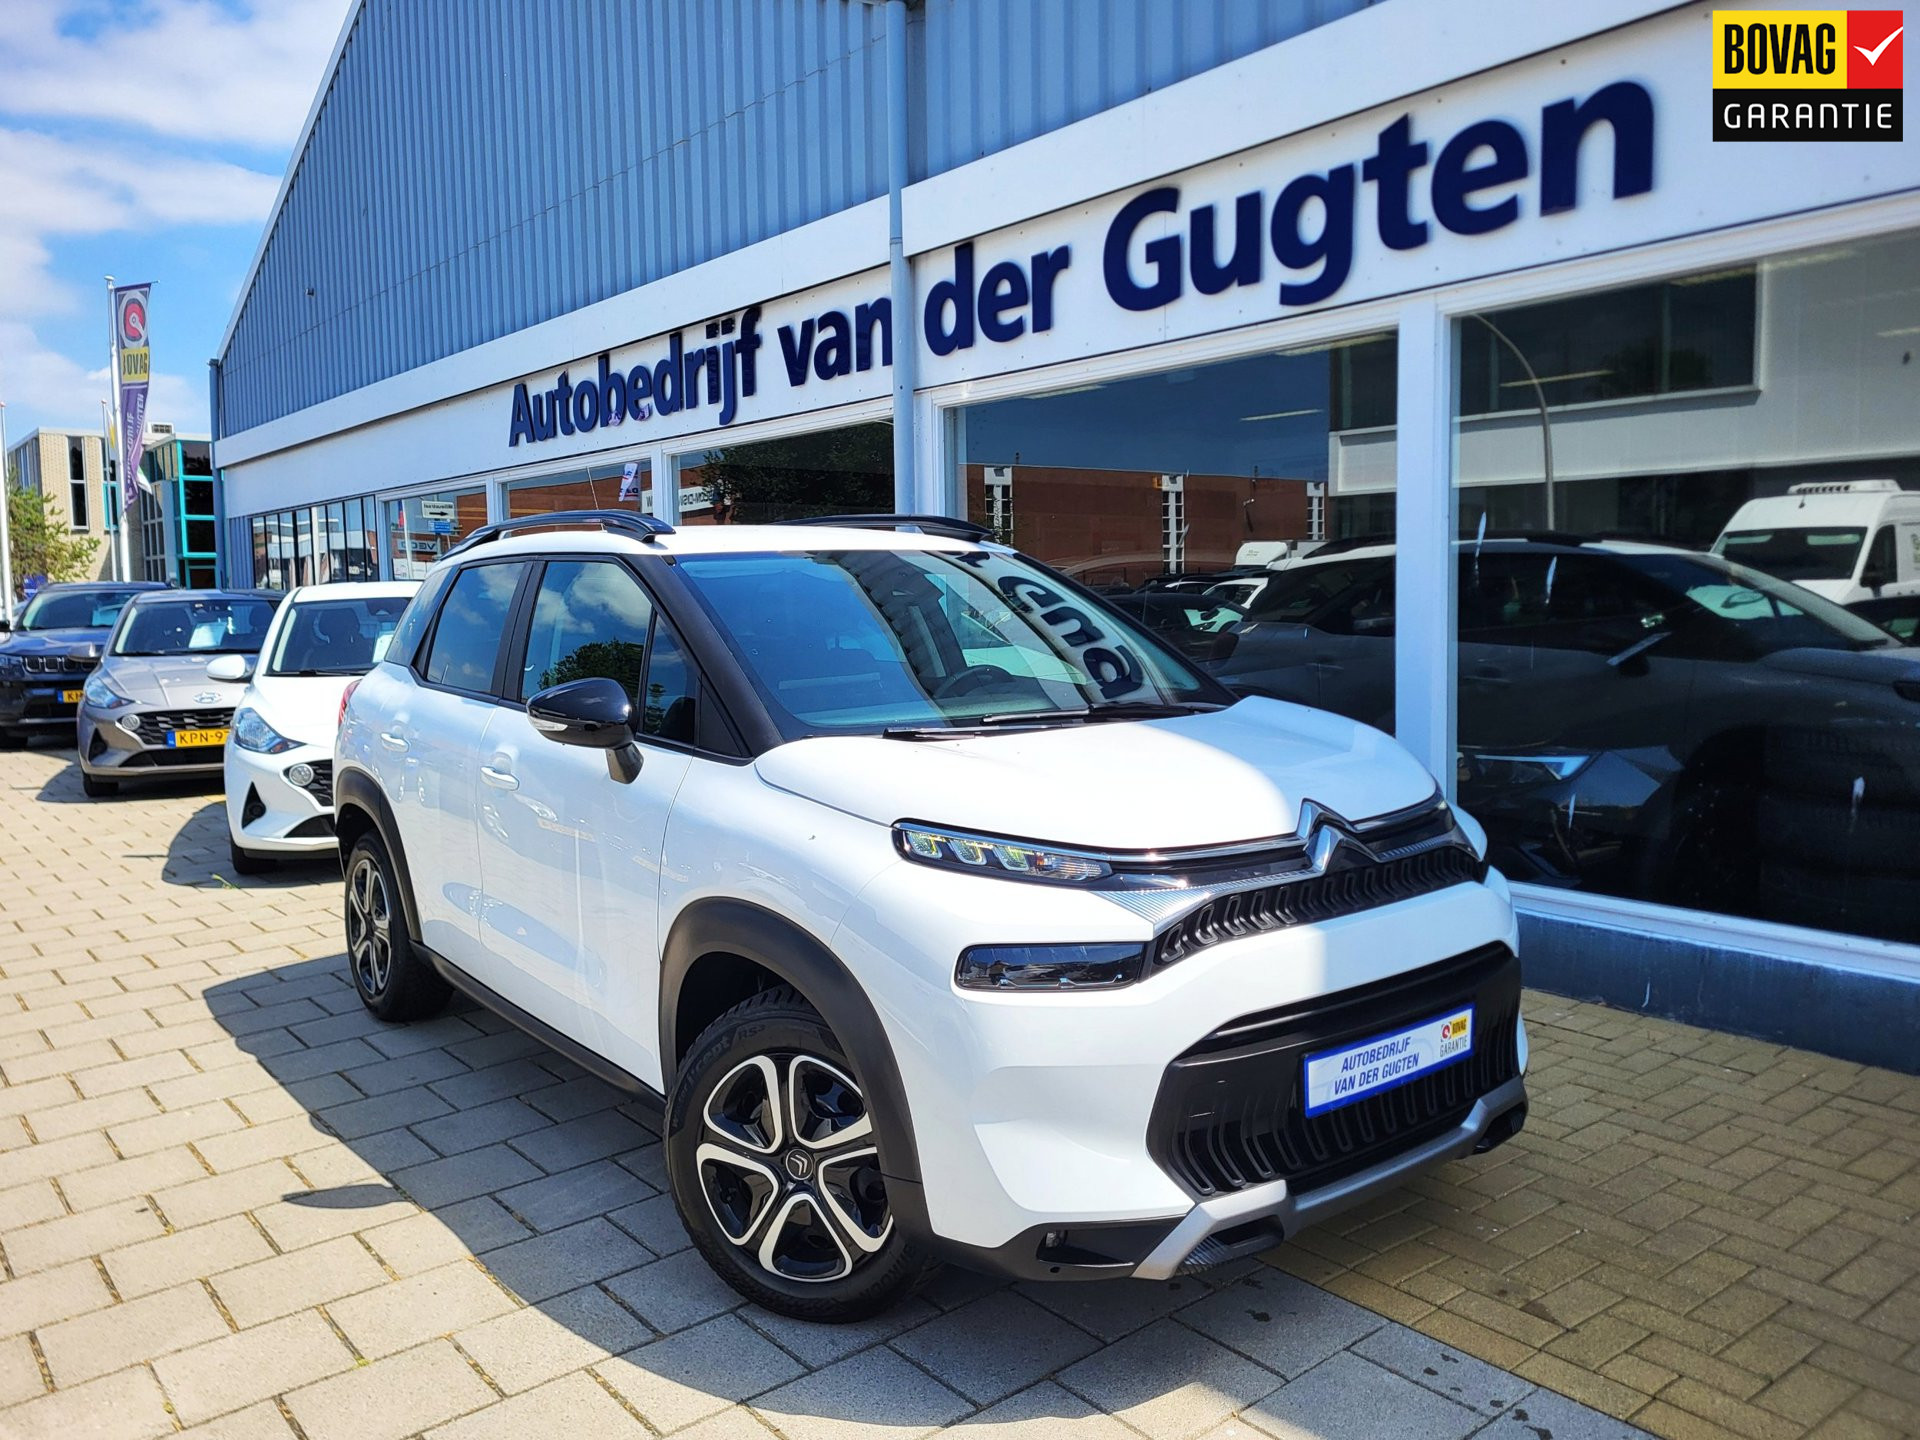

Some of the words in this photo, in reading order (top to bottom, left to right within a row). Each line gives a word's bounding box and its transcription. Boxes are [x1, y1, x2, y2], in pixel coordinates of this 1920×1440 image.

[508, 305, 763, 448] Autobedrijf
[777, 298, 893, 387] van
[924, 240, 1070, 357] der
[1103, 81, 1655, 312] Gugten
[1341, 1036, 1412, 1074] AUTOBEDRIJF
[1439, 1035, 1468, 1058] GARANTIE
[1334, 1077, 1356, 1096] VAN
[1358, 1070, 1379, 1087] DER
[1382, 1053, 1420, 1080] GUGTEN
